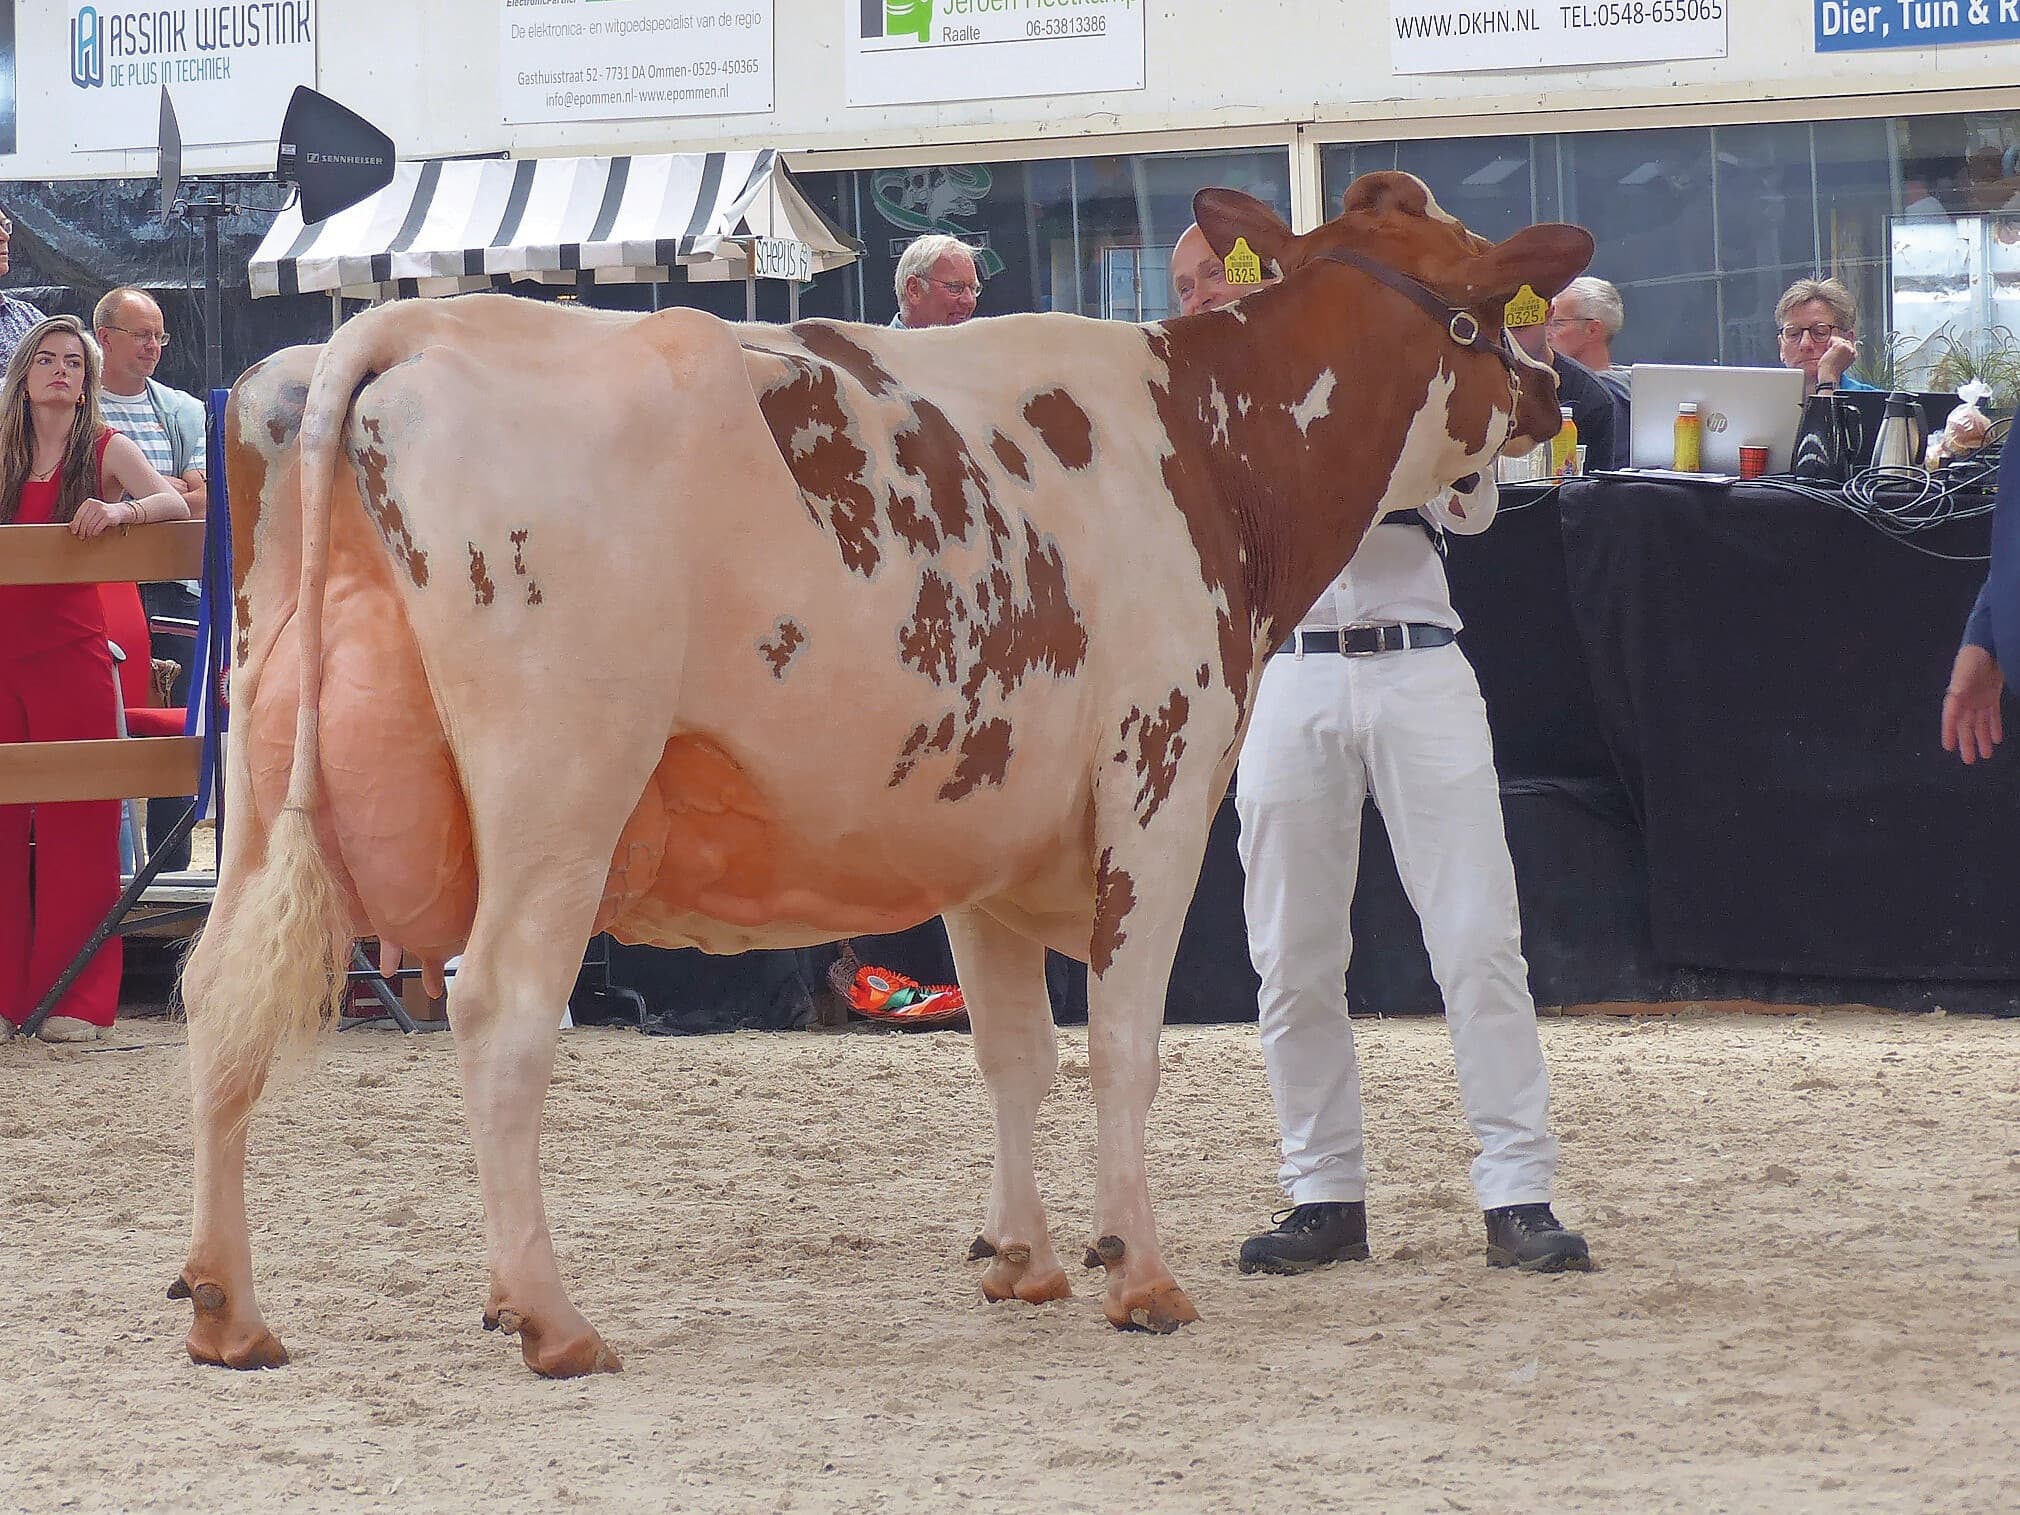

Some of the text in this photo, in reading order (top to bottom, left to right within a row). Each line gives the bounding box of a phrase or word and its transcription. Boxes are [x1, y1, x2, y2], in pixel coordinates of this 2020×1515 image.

[110, 0, 311, 57] ASSINK WEUSTINK
[511, 9, 762, 39] De elektronica- en witgoedspecialist van de regio
[943, 15, 1106, 42] Raalte 06-53813386
[1395, 0, 1723, 39] WWW.DKHN.NL TEL:0548-655065
[1822, 0, 2019, 38] Dier, Tuin & R
[110, 56, 231, 87] DE PLUS IN TECHNIEK
[517, 69, 584, 86] Gasthuisstraat
[586, 67, 598, 82] 52
[605, 66, 630, 81] 7731
[632, 65, 646, 79] DA
[321, 154, 383, 165] SENNHEISER
[1227, 268, 1256, 283] 0325
[1506, 309, 1539, 325] 0325
